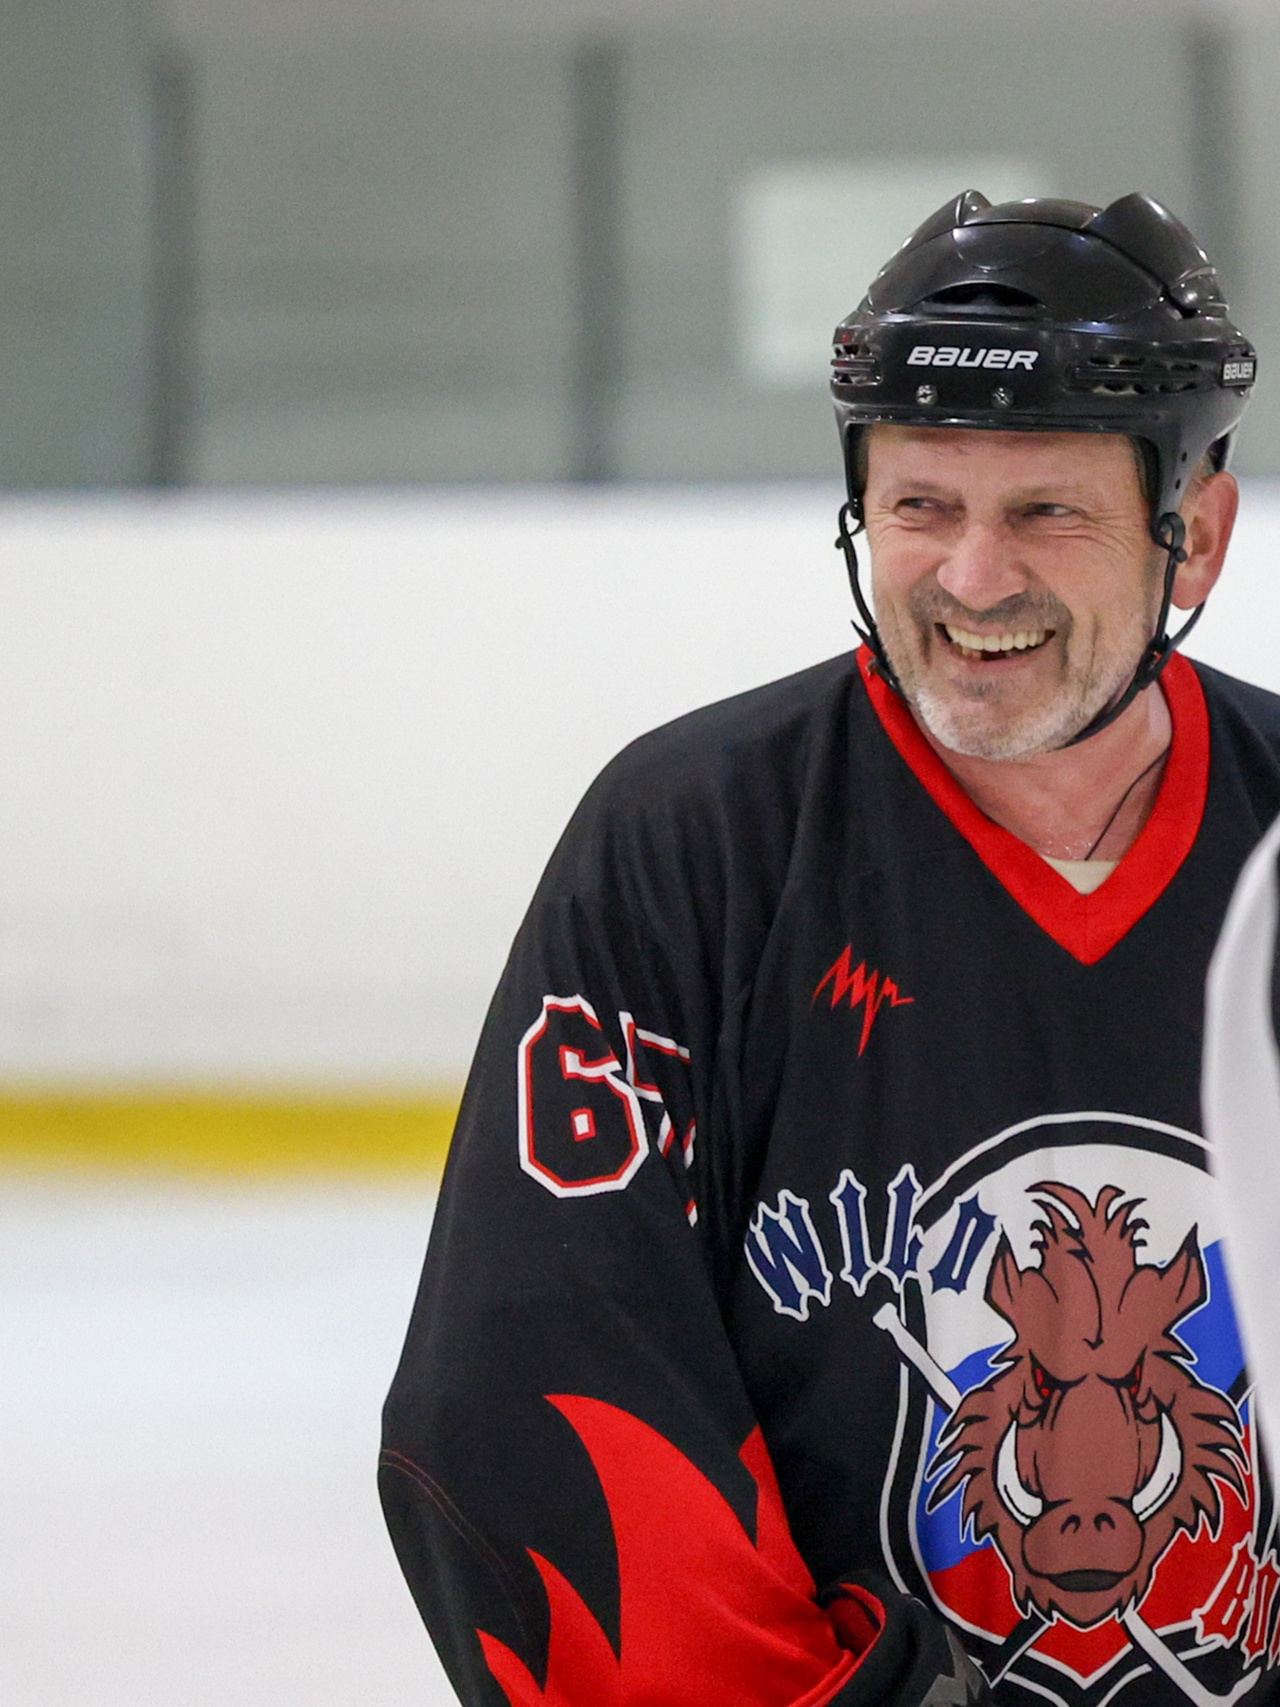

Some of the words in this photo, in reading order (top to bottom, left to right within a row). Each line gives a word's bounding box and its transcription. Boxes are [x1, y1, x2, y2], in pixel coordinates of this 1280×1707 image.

[906, 344, 1039, 371] BAUER
[1223, 362, 1254, 380] BAUER
[743, 1163, 1000, 1321] WILD
